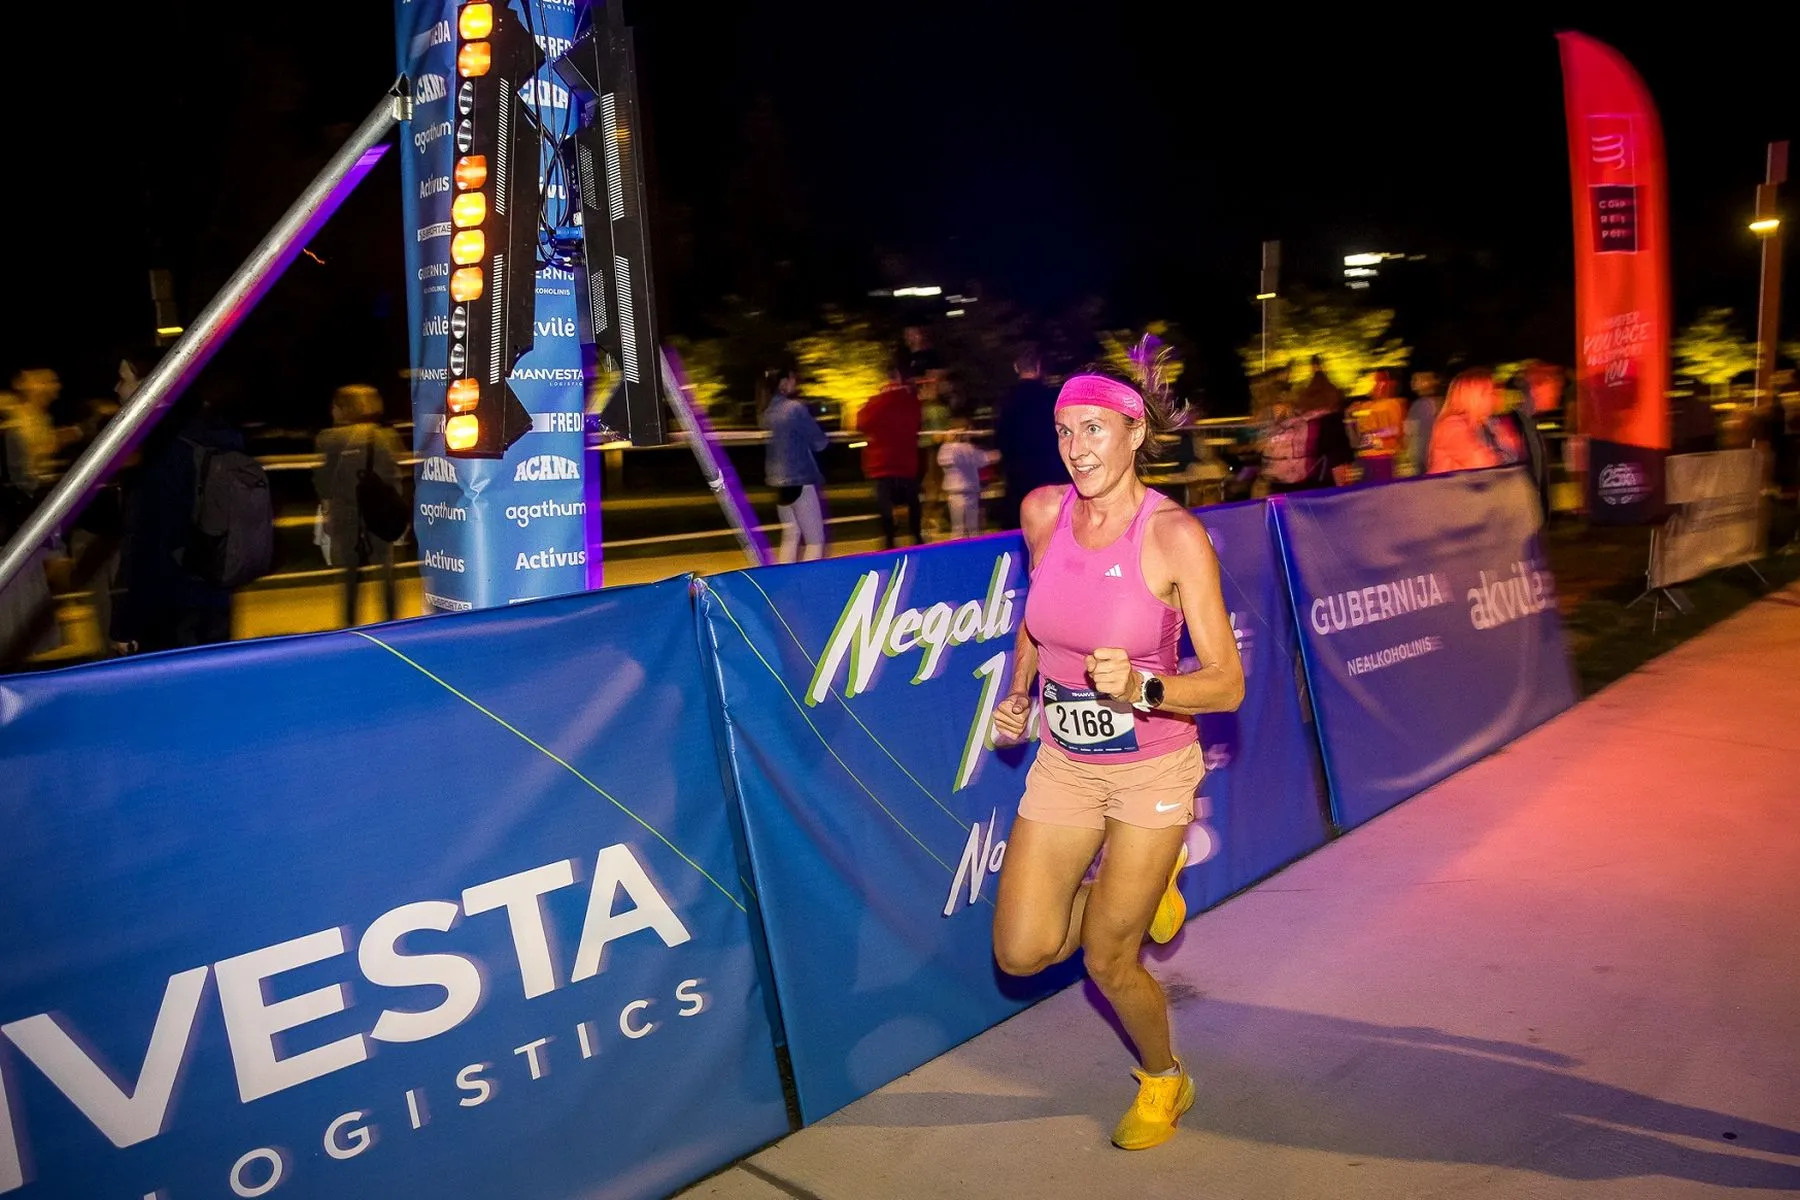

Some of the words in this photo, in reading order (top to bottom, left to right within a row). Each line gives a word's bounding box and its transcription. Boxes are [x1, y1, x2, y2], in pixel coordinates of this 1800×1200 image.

[421, 456, 458, 483] ACANA
[514, 455, 581, 482] ACANA
[420, 501, 467, 526] agathum
[505, 499, 587, 528] agathum
[1311, 573, 1444, 635] GUBERNIJA
[1347, 636, 1433, 676] NEALKOHOLINIS
[1056, 704, 1115, 738] 2168
[143, 979, 706, 1200] OGISTICS
